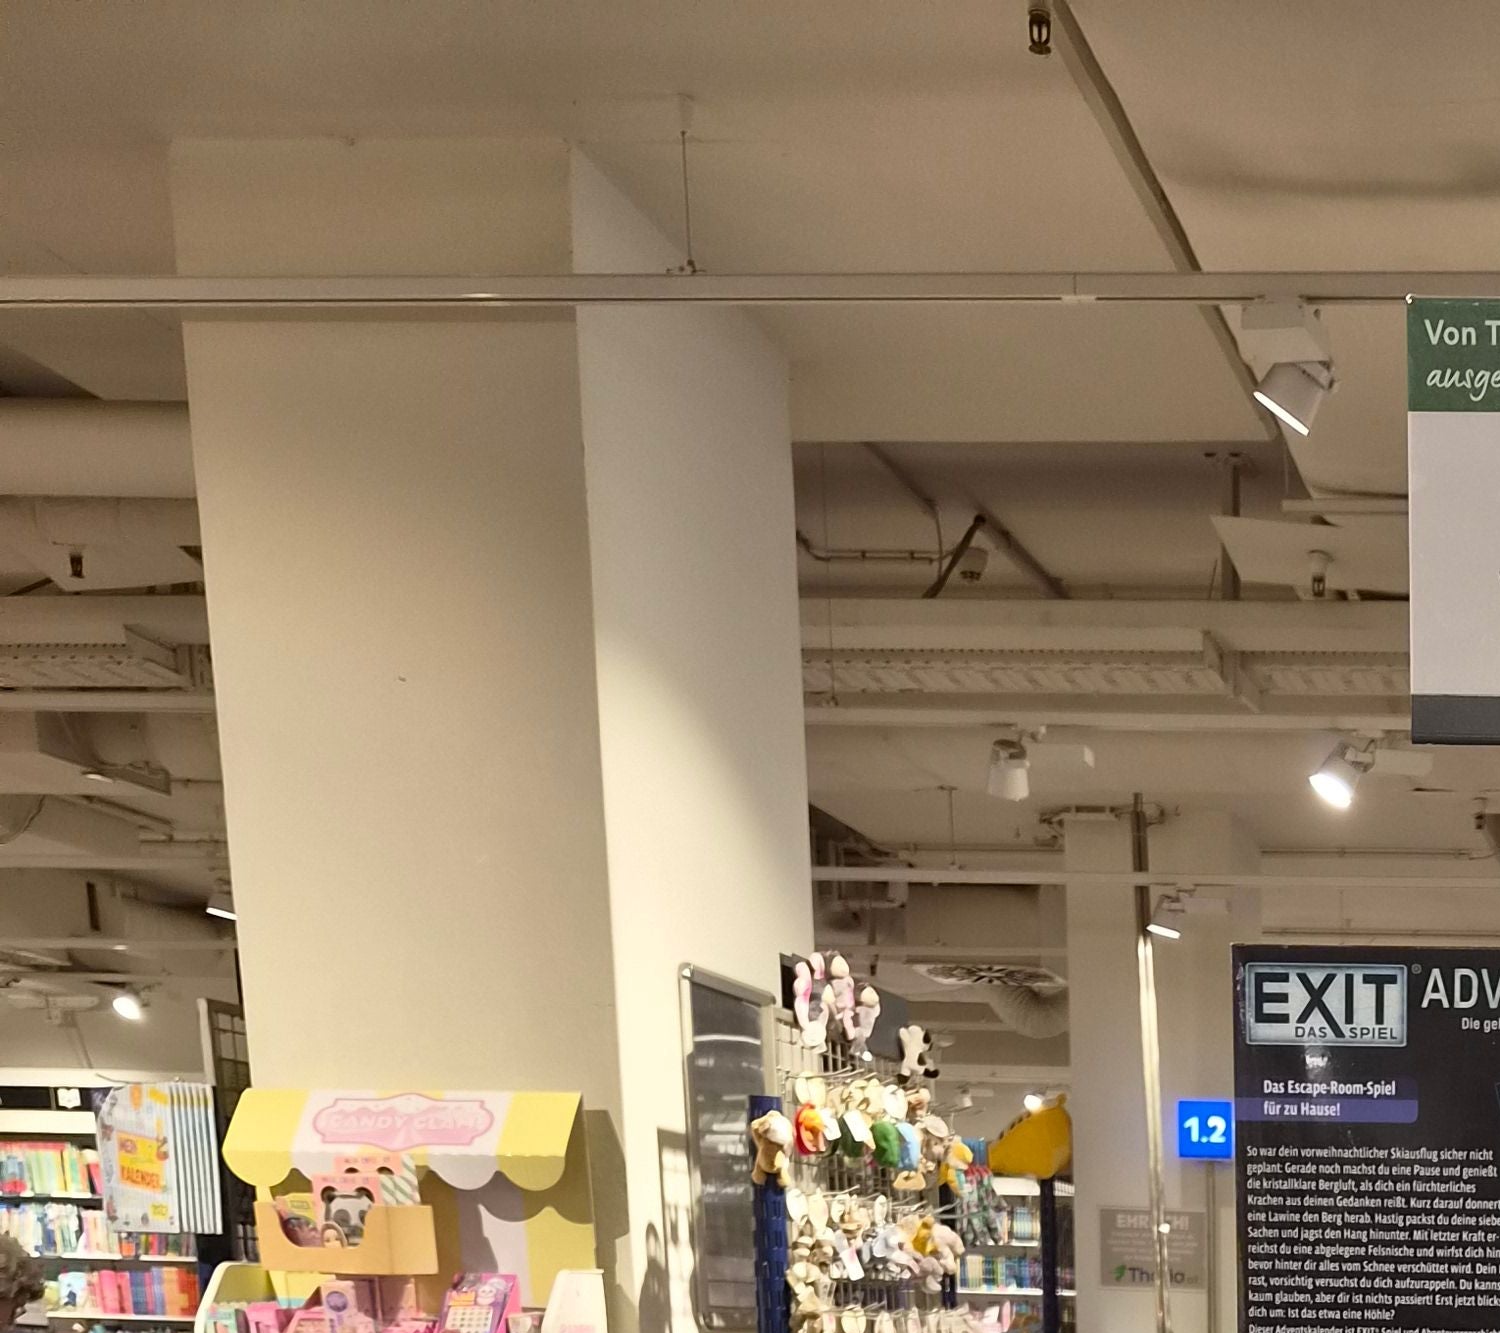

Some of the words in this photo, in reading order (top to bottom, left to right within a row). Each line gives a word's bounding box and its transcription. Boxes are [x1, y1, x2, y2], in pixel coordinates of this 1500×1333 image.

[1424, 319, 1477, 347] Von
[1253, 971, 1398, 1038] EXIT
[1294, 1025, 1328, 1039] DAS
[1348, 1026, 1398, 1041] SPIEL
[1461, 1016, 1480, 1032] Die
[1262, 1079, 1285, 1094] Das
[1287, 1079, 1396, 1098] Escape-Room-Spiel
[1262, 1100, 1282, 1116] für
[1283, 1104, 1299, 1116] zu
[1300, 1101, 1342, 1117] Hause!
[1184, 1117, 1227, 1144] 1.2
